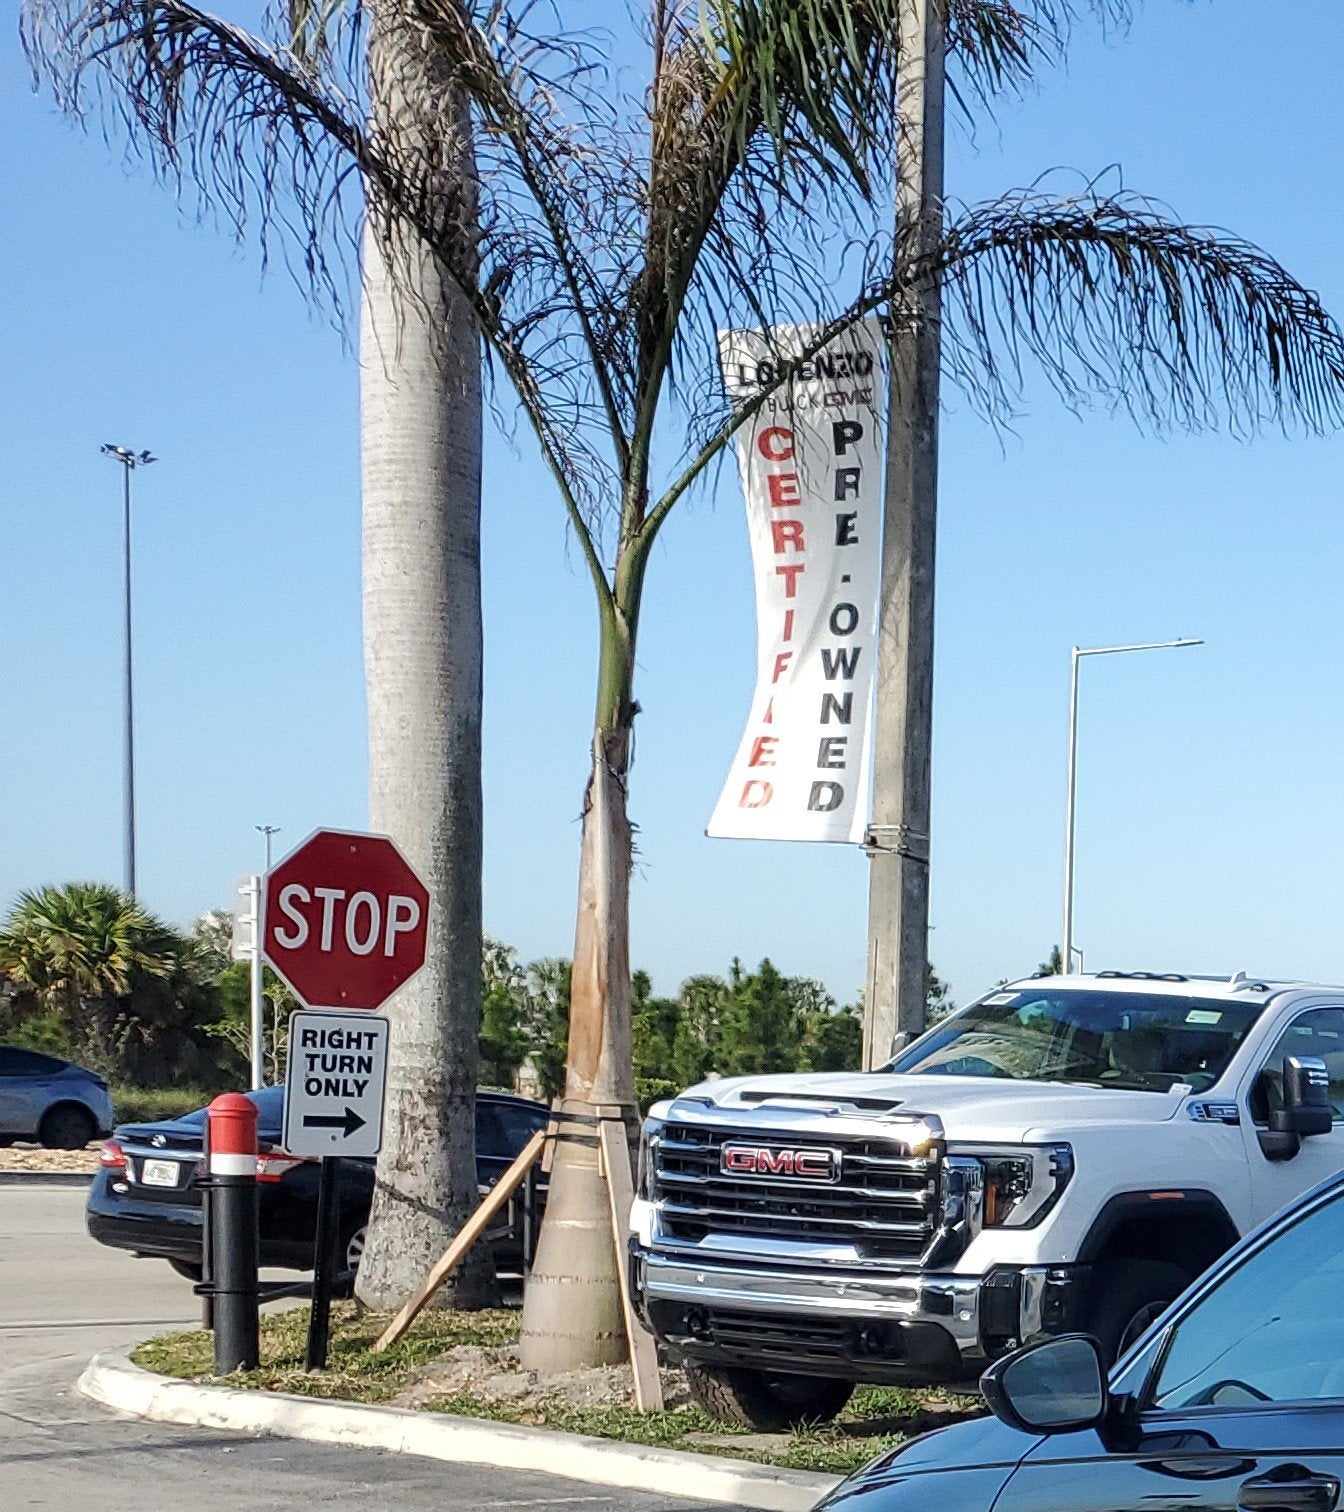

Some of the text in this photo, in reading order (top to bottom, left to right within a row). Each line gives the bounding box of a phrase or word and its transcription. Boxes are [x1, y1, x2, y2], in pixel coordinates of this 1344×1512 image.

[739, 351, 873, 386] LOENZO
[738, 426, 806, 809] CERTIFIED
[274, 883, 420, 957] STOP
[301, 1028, 378, 1050] RIGHT
[305, 1053, 373, 1074] TURN
[305, 1078, 369, 1098] ONLY
[726, 1147, 830, 1176] GMC
